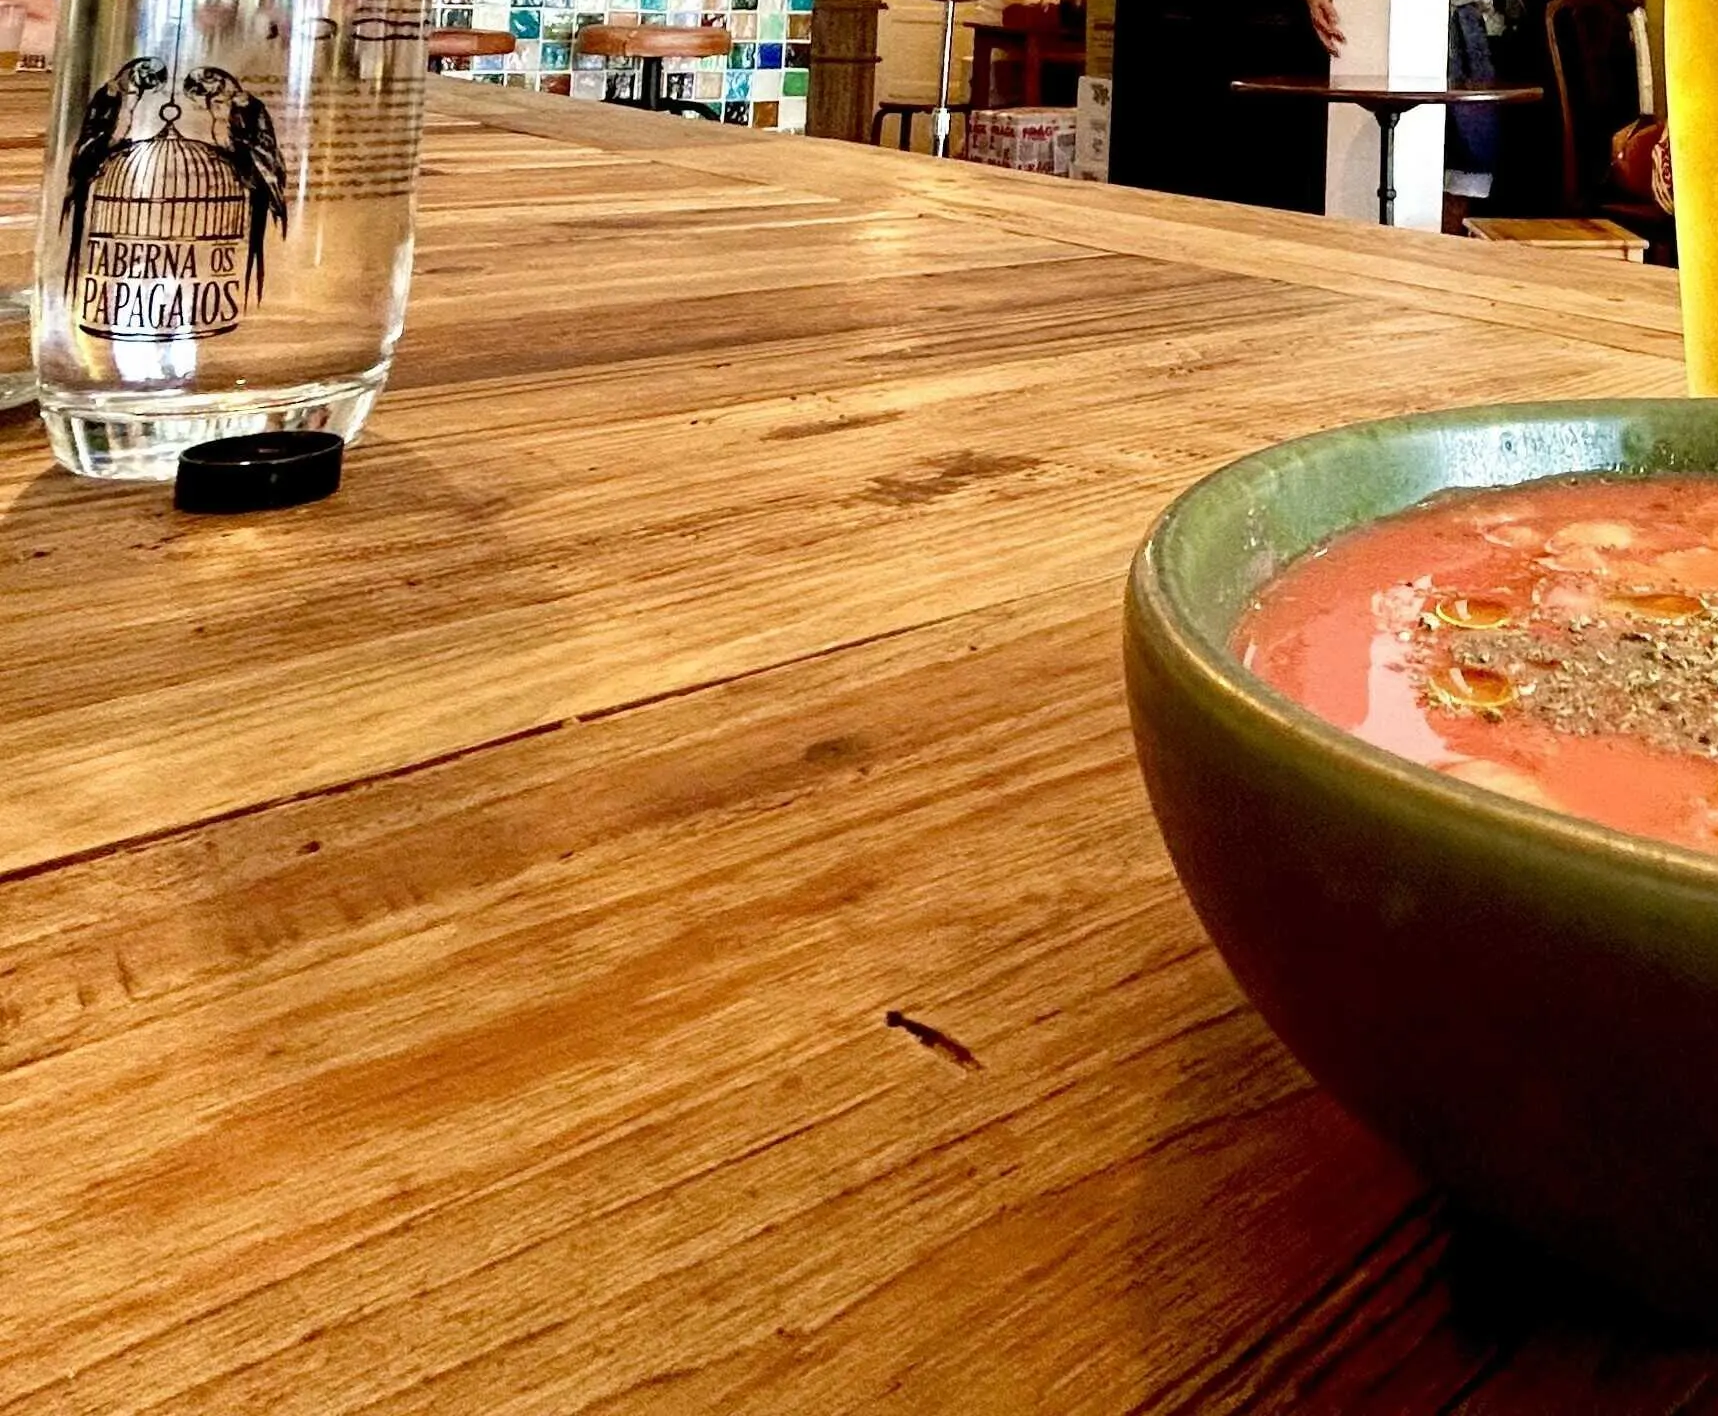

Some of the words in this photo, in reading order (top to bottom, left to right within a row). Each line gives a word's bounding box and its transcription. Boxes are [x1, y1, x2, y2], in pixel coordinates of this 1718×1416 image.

[88, 240, 198, 279] TABERNA
[210, 247, 236, 273] OS
[82, 277, 240, 329] PAPAGAIOS
